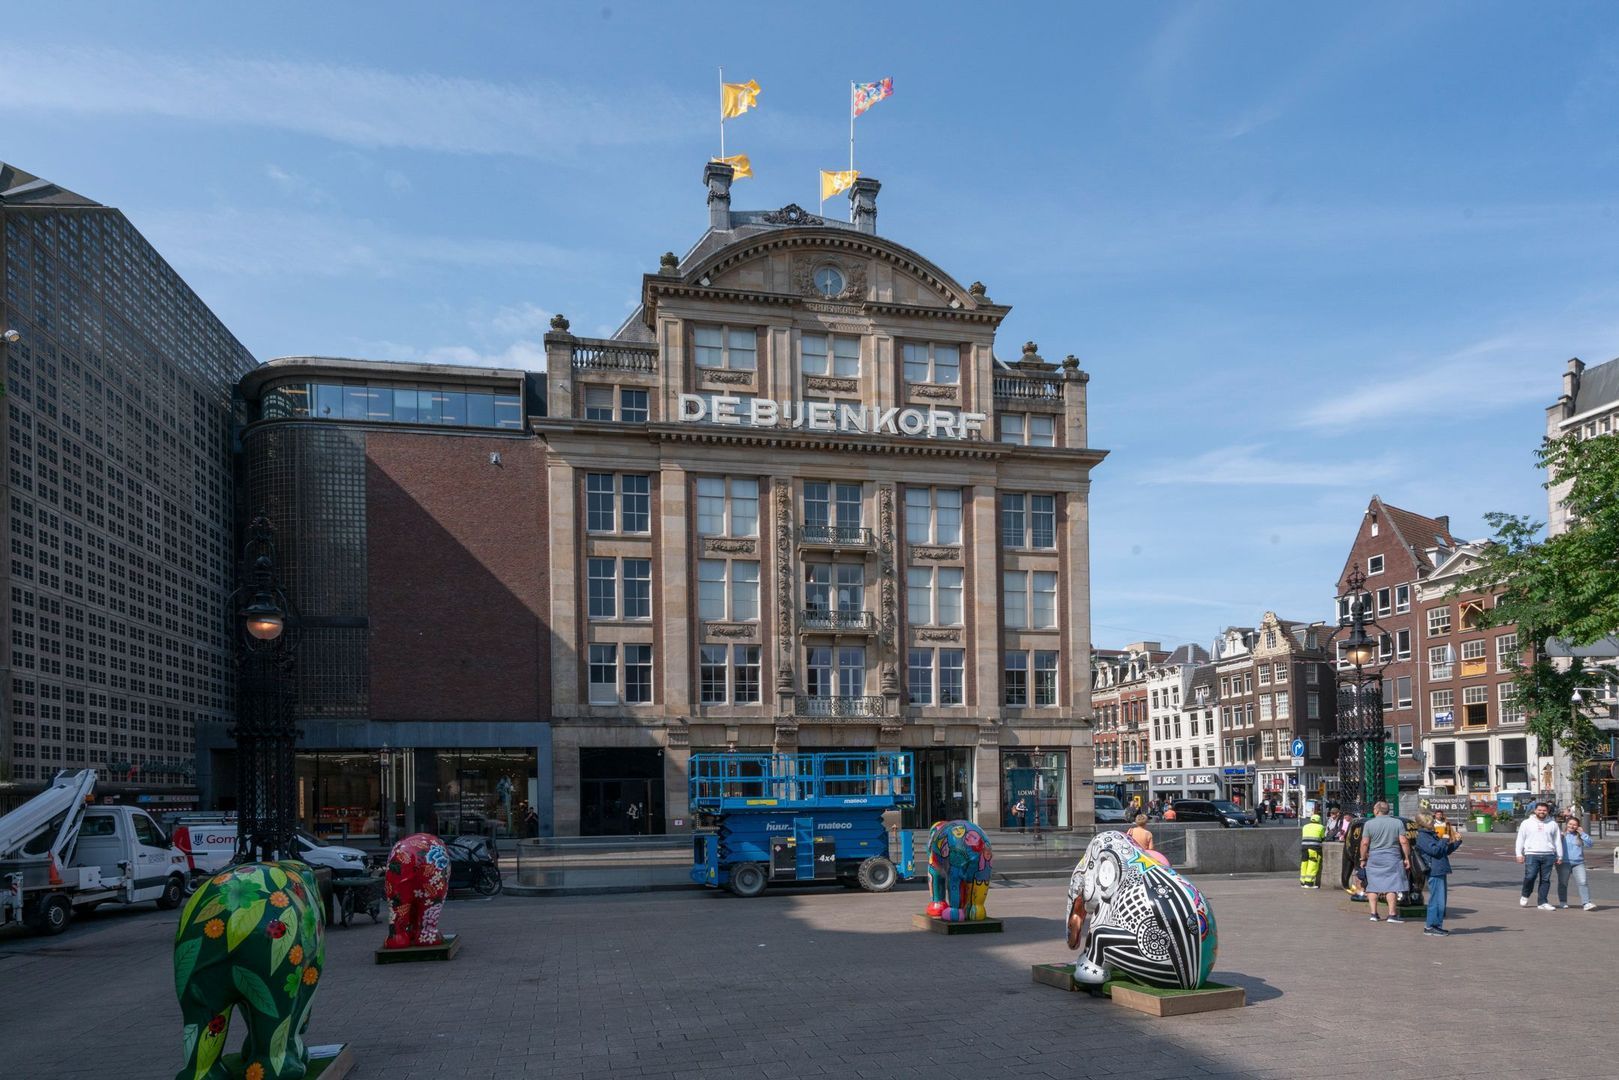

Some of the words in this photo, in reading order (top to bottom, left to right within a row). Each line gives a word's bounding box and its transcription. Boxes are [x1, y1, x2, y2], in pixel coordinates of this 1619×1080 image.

[679, 393, 741, 425] DE
[751, 397, 986, 439] BIJENKORF
[1162, 777, 1176, 785] KFC
[1197, 775, 1210, 784] KFC
[818, 822, 852, 830] mateco
[206, 834, 236, 844] Gom
[819, 854, 836, 862] 4x4
